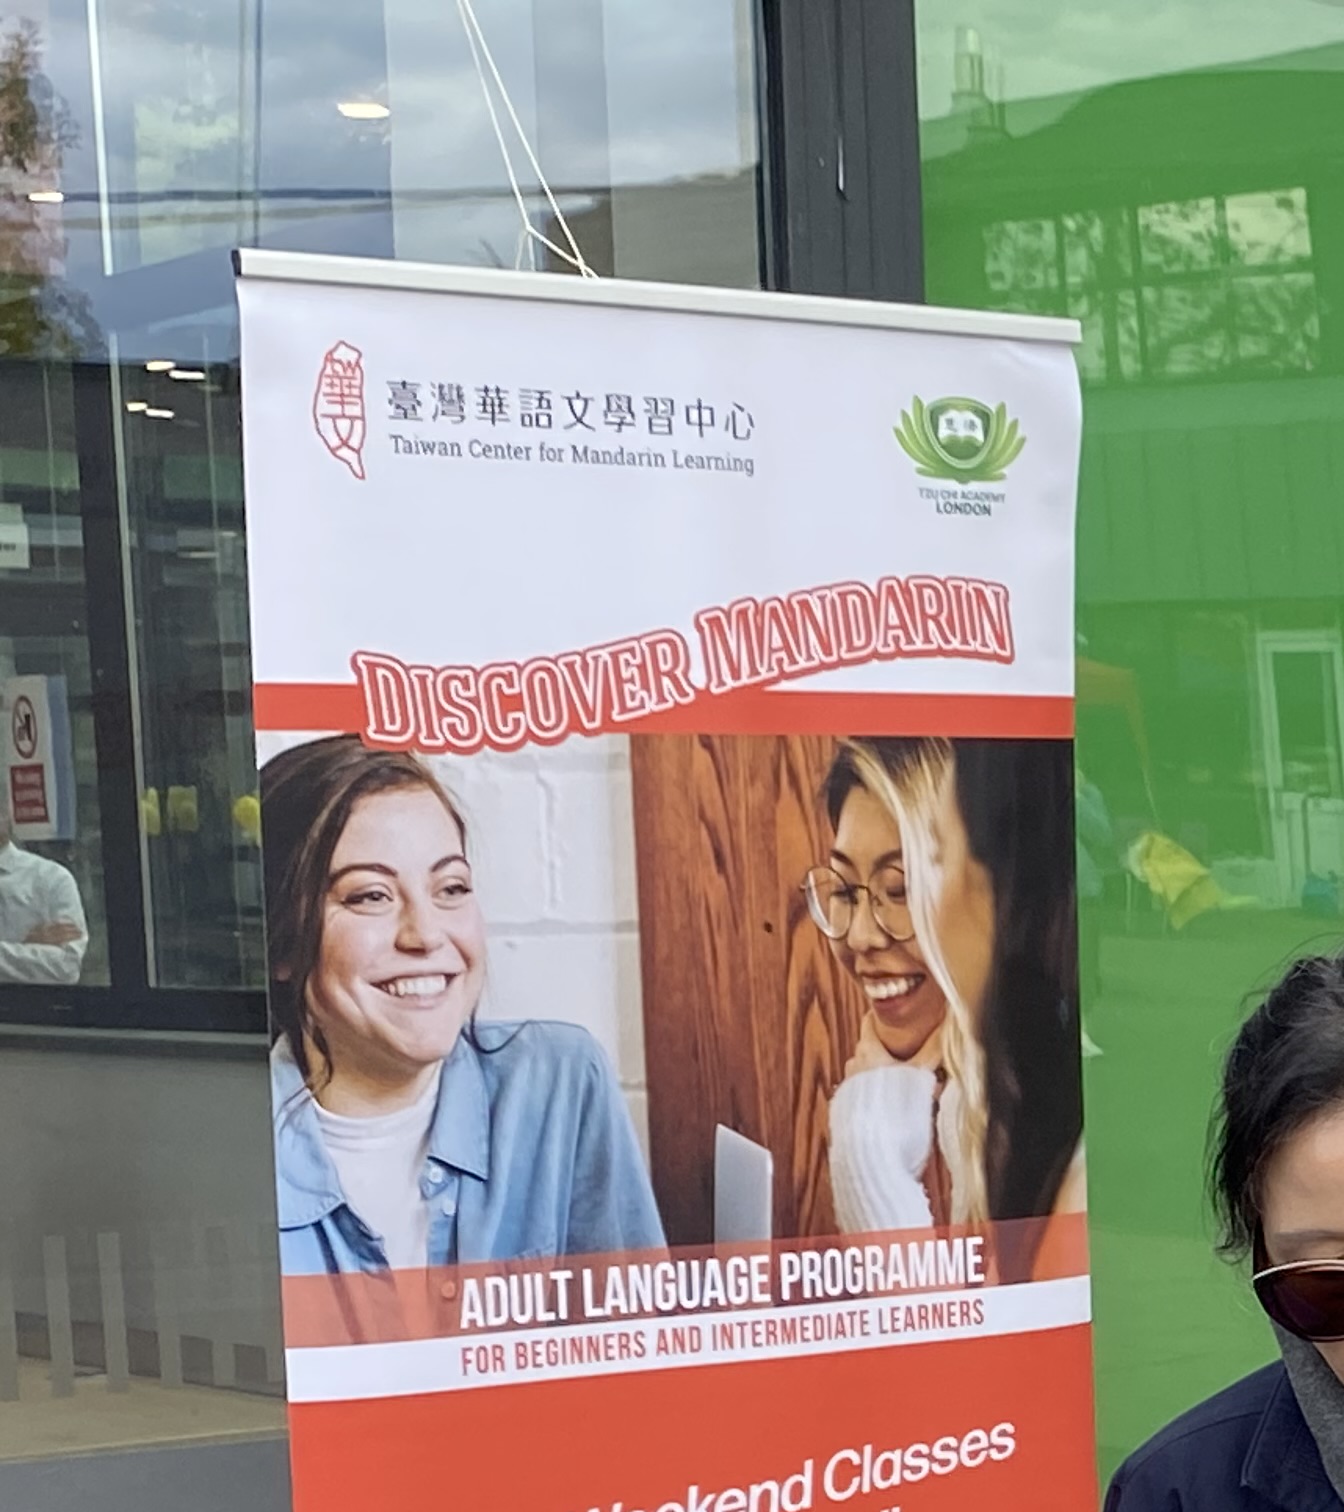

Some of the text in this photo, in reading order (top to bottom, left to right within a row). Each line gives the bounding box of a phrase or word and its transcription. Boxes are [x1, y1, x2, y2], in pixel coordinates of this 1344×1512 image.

[385, 378, 757, 441] 臺灣華語文學習中心
[389, 434, 755, 475] Taiwan Center for Mandarin Learning
[936, 502, 991, 516] LONDON
[357, 577, 1014, 748] DISCOVER MANDARIN
[460, 1238, 984, 1328] ADULT LANGUAGE PROGRAMME
[461, 1300, 985, 1375] FOR BEGINNERS AND INTERMEDIATE LEARNERS
[824, 1421, 1016, 1502] Classes
